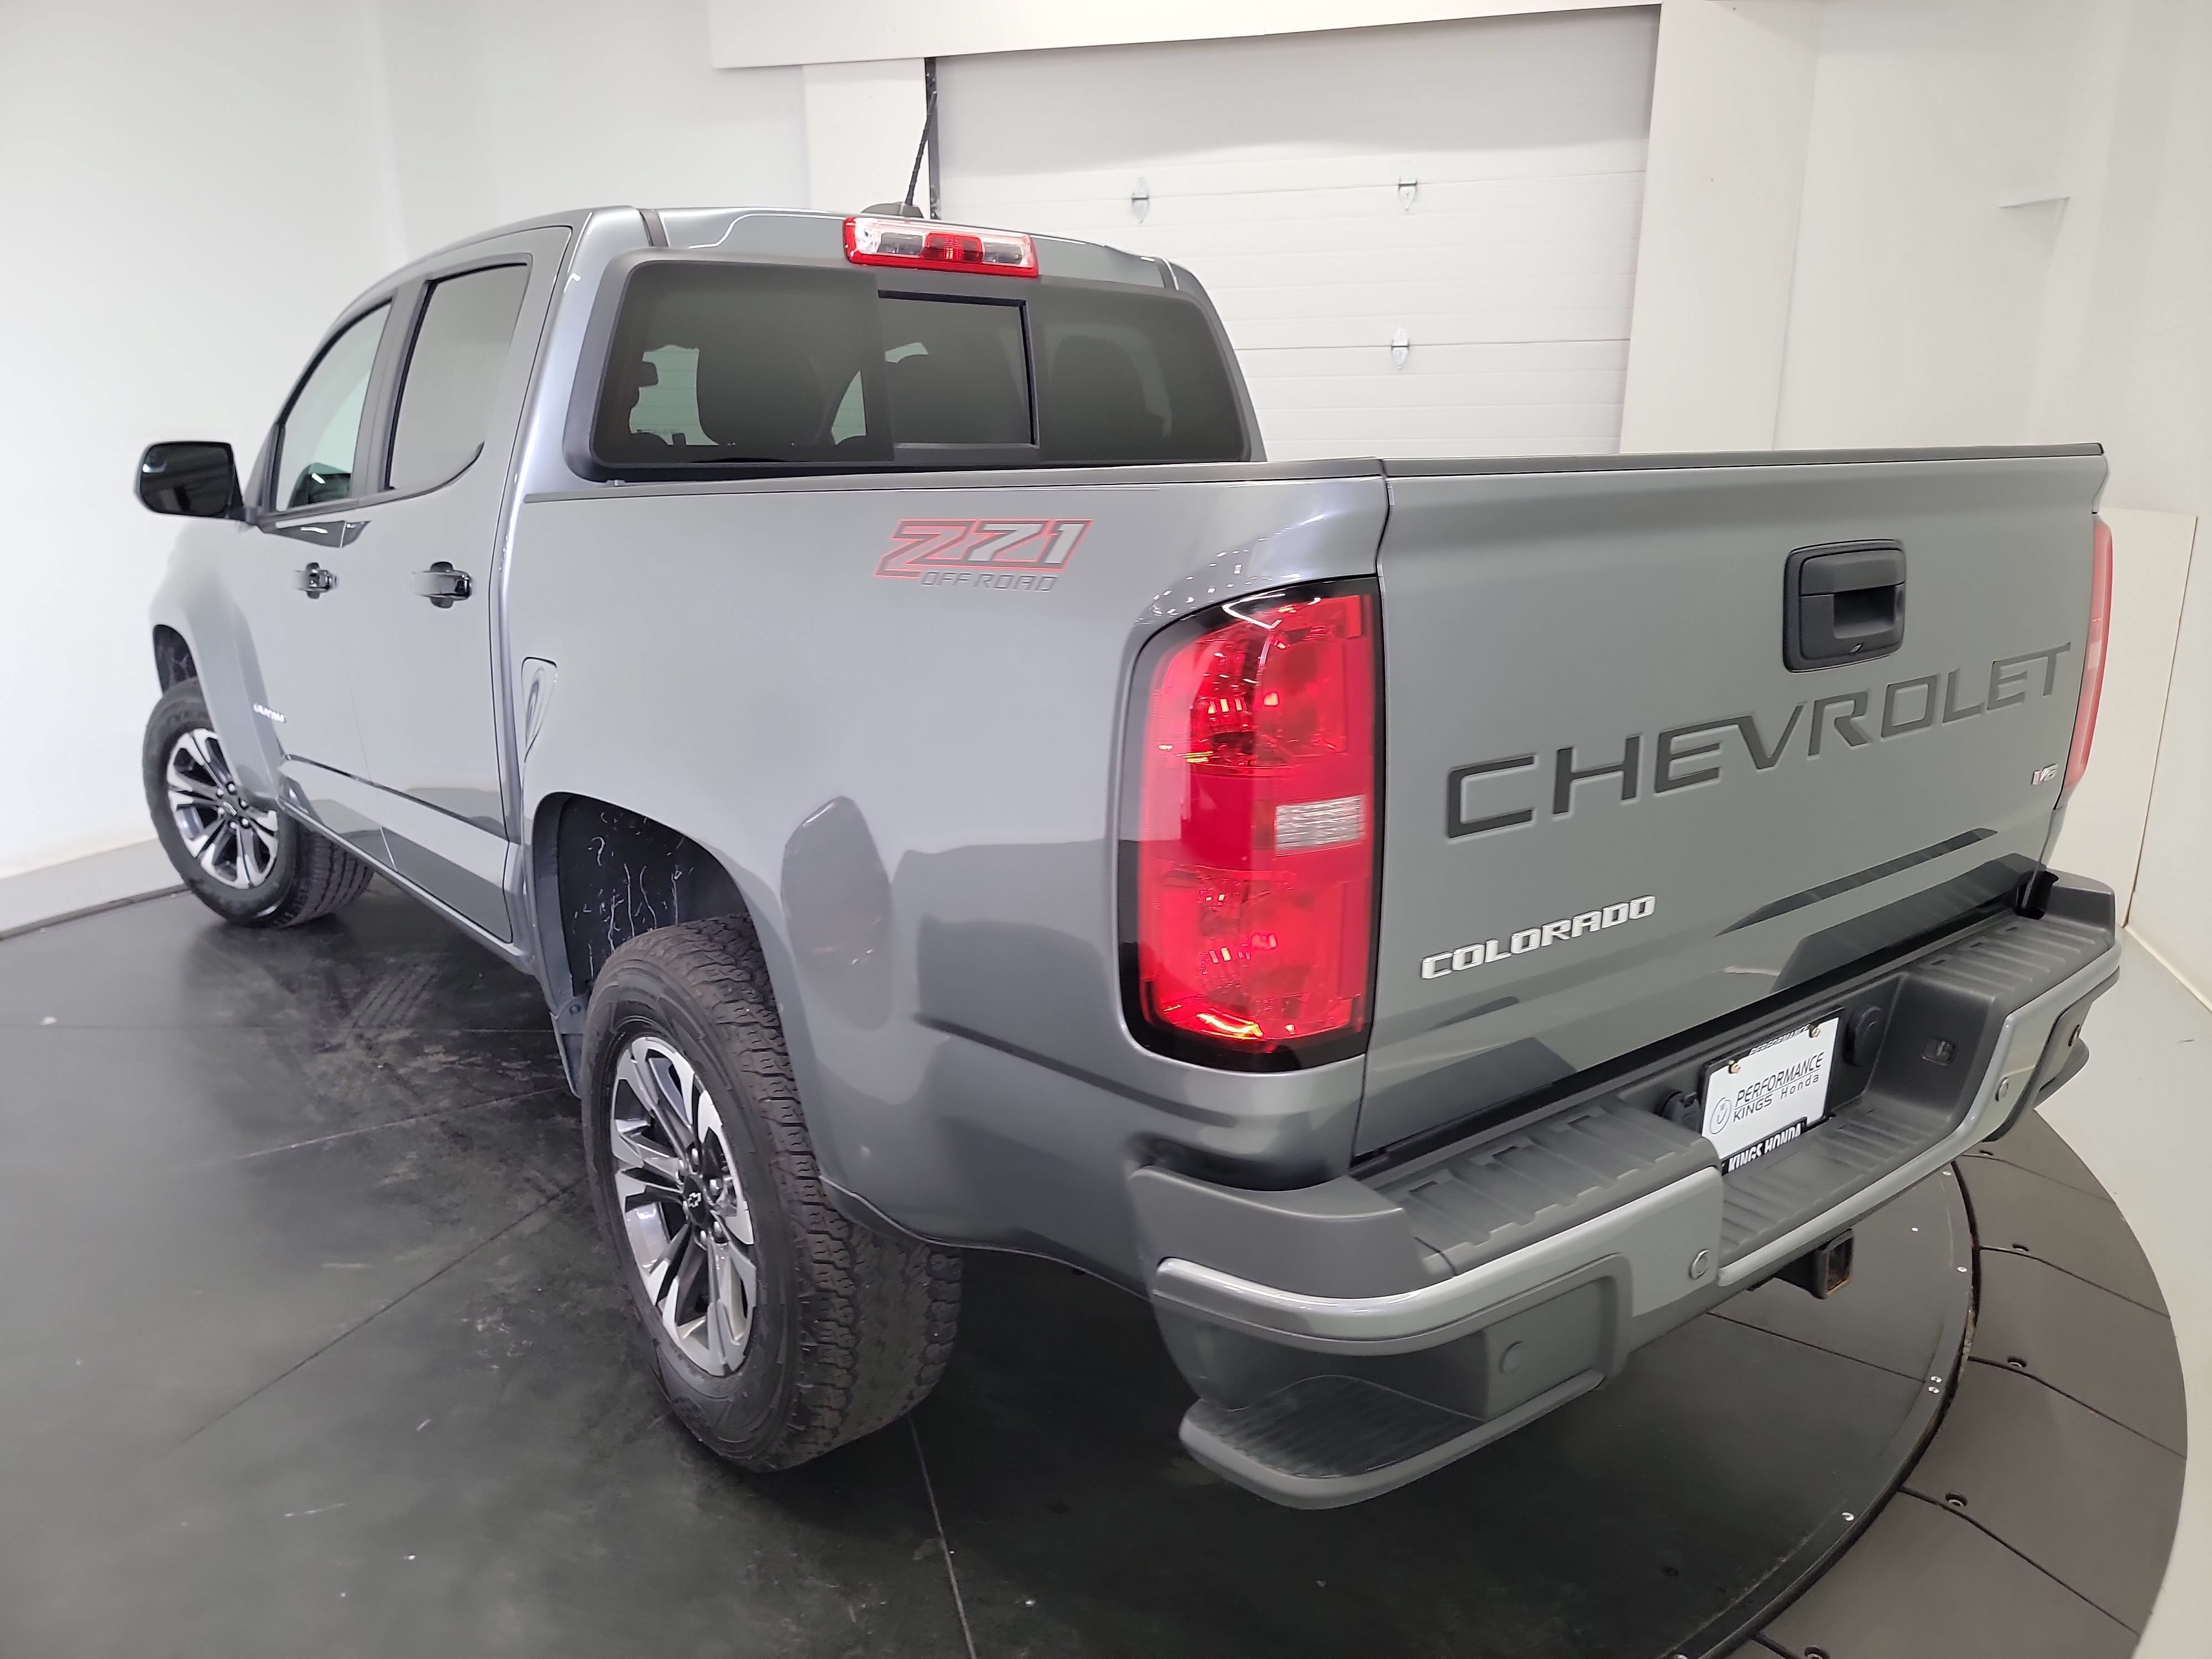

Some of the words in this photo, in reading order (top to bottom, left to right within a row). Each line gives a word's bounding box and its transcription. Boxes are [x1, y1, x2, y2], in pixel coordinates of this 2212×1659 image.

[874, 519, 1094, 579] Z71
[921, 571, 972, 586] OFF
[973, 573, 1058, 592] ROAD
[1447, 643, 2069, 839] CHEVROLET
[2031, 763, 2058, 785] V6
[1421, 894, 1656, 979] COLORADO
[1732, 1094, 1773, 1123] KINGS
[1780, 1073, 1819, 1099] Honda
[1735, 1052, 1824, 1107] PERFORMANCE
[1728, 1142, 1764, 1172] KINGS
[1764, 1123, 1801, 1154] HONDA
